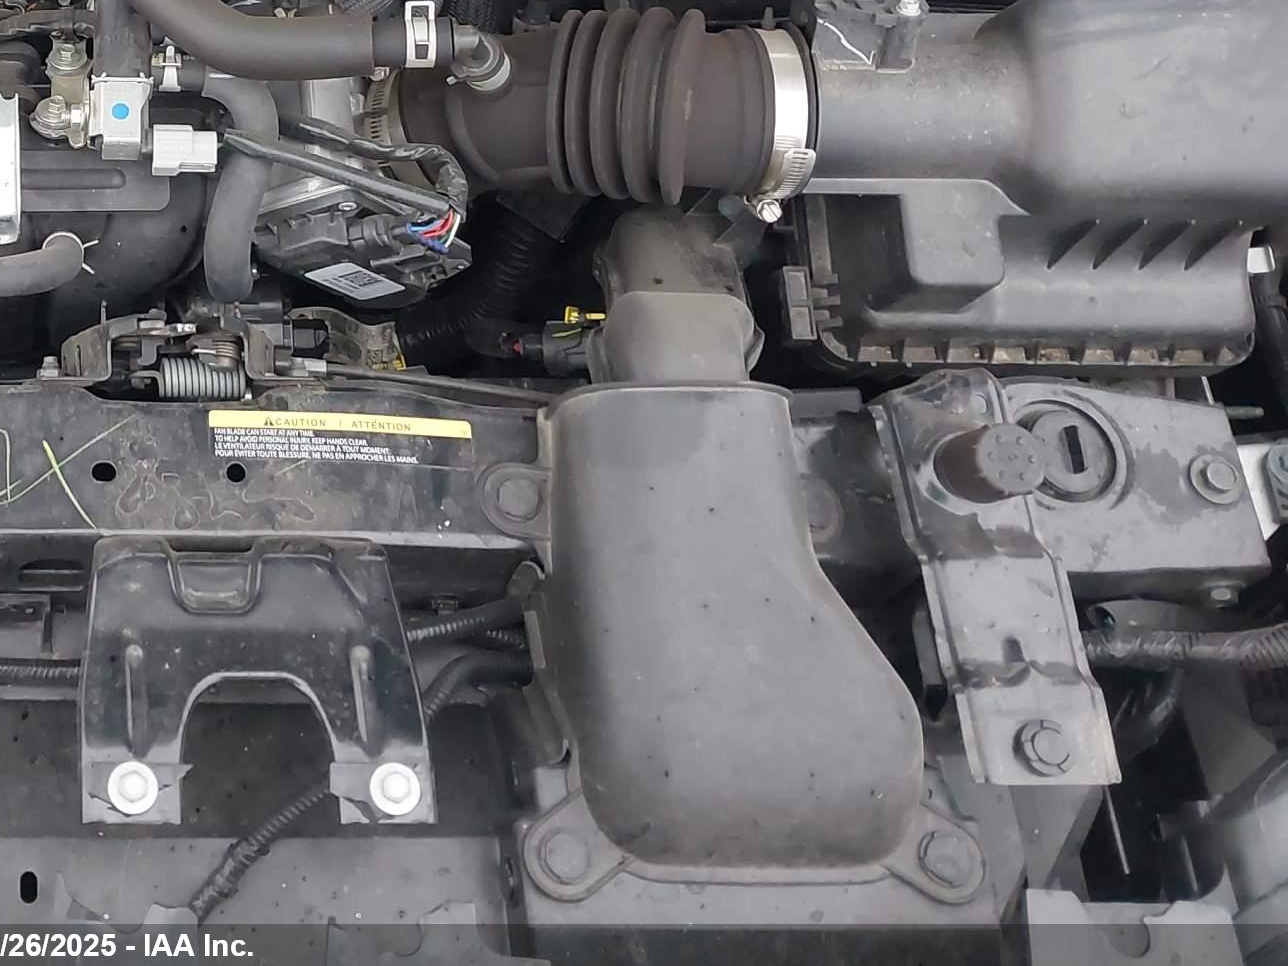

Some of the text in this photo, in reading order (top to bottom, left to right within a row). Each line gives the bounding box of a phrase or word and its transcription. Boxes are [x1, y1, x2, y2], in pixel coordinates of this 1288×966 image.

[274, 417, 327, 428] CAUTION
[214, 427, 226, 435] FAN
[226, 427, 245, 435] BLADE
[260, 428, 277, 436] START
[278, 428, 286, 436] AT
[286, 429, 299, 437] ANY
[214, 435, 224, 443] TO
[224, 435, 239, 443] HELP
[240, 436, 259, 444] AVOID
[259, 436, 289, 444] PERSONAL
[311, 437, 326, 445] KEEP
[326, 438, 348, 446] HANDS
[214, 442, 223, 450] LE
[223, 442, 265, 451] VENTILATEUR
[265, 443, 289, 451] RISQUE
[214, 449, 234, 458] POUR
[257, 450, 278, 459] TOUTE
[312, 452, 321, 460] NE
[322, 452, 334, 460] PAS
[345, 454, 383, 462] APPROCHER
